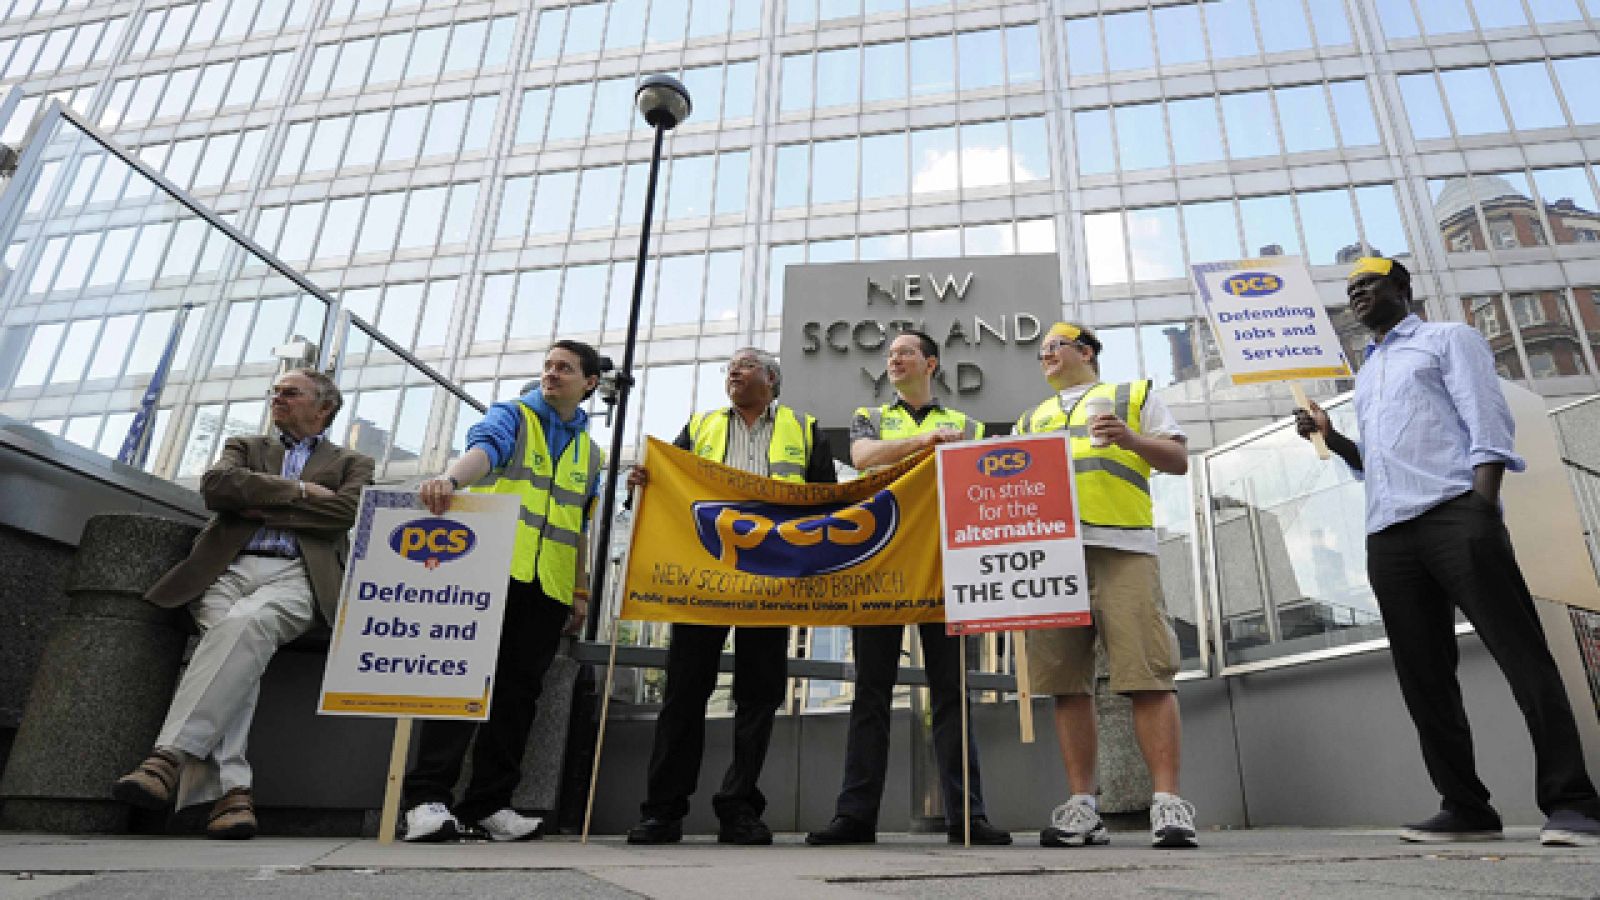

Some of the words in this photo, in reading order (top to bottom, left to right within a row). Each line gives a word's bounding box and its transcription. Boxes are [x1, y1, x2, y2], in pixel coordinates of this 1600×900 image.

[867, 271, 975, 306] NEW
[1229, 276, 1279, 296] pcs
[1217, 305, 1316, 323] Defending
[802, 312, 1042, 353] SCOTAND
[1234, 327, 1275, 341] Jobs
[1282, 324, 1316, 336] and
[1241, 345, 1323, 360] Services
[983, 452, 1026, 476] pcs
[967, 484, 996, 503] On
[1000, 480, 1046, 498] strike
[979, 503, 1003, 521] for
[1007, 500, 1038, 518] the
[400, 527, 469, 558] pcs
[715, 500, 877, 571] pcs
[954, 519, 1066, 544] alternative
[979, 550, 1046, 575] STOP
[652, 563, 698, 586] NEW
[697, 570, 784, 596] SCOTLAND
[789, 577, 828, 598] YARD
[831, 570, 905, 598] BRANCH
[952, 582, 1004, 604] THE
[1011, 575, 1079, 599] CUTS
[359, 582, 491, 611] Defending
[629, 590, 663, 603] Public
[667, 595, 688, 605] and
[690, 595, 757, 609] Commercial
[760, 600, 808, 611] Services
[812, 599, 848, 611] Union
[361, 616, 420, 638] Jobs
[429, 621, 477, 641] and
[357, 651, 468, 676] Services
